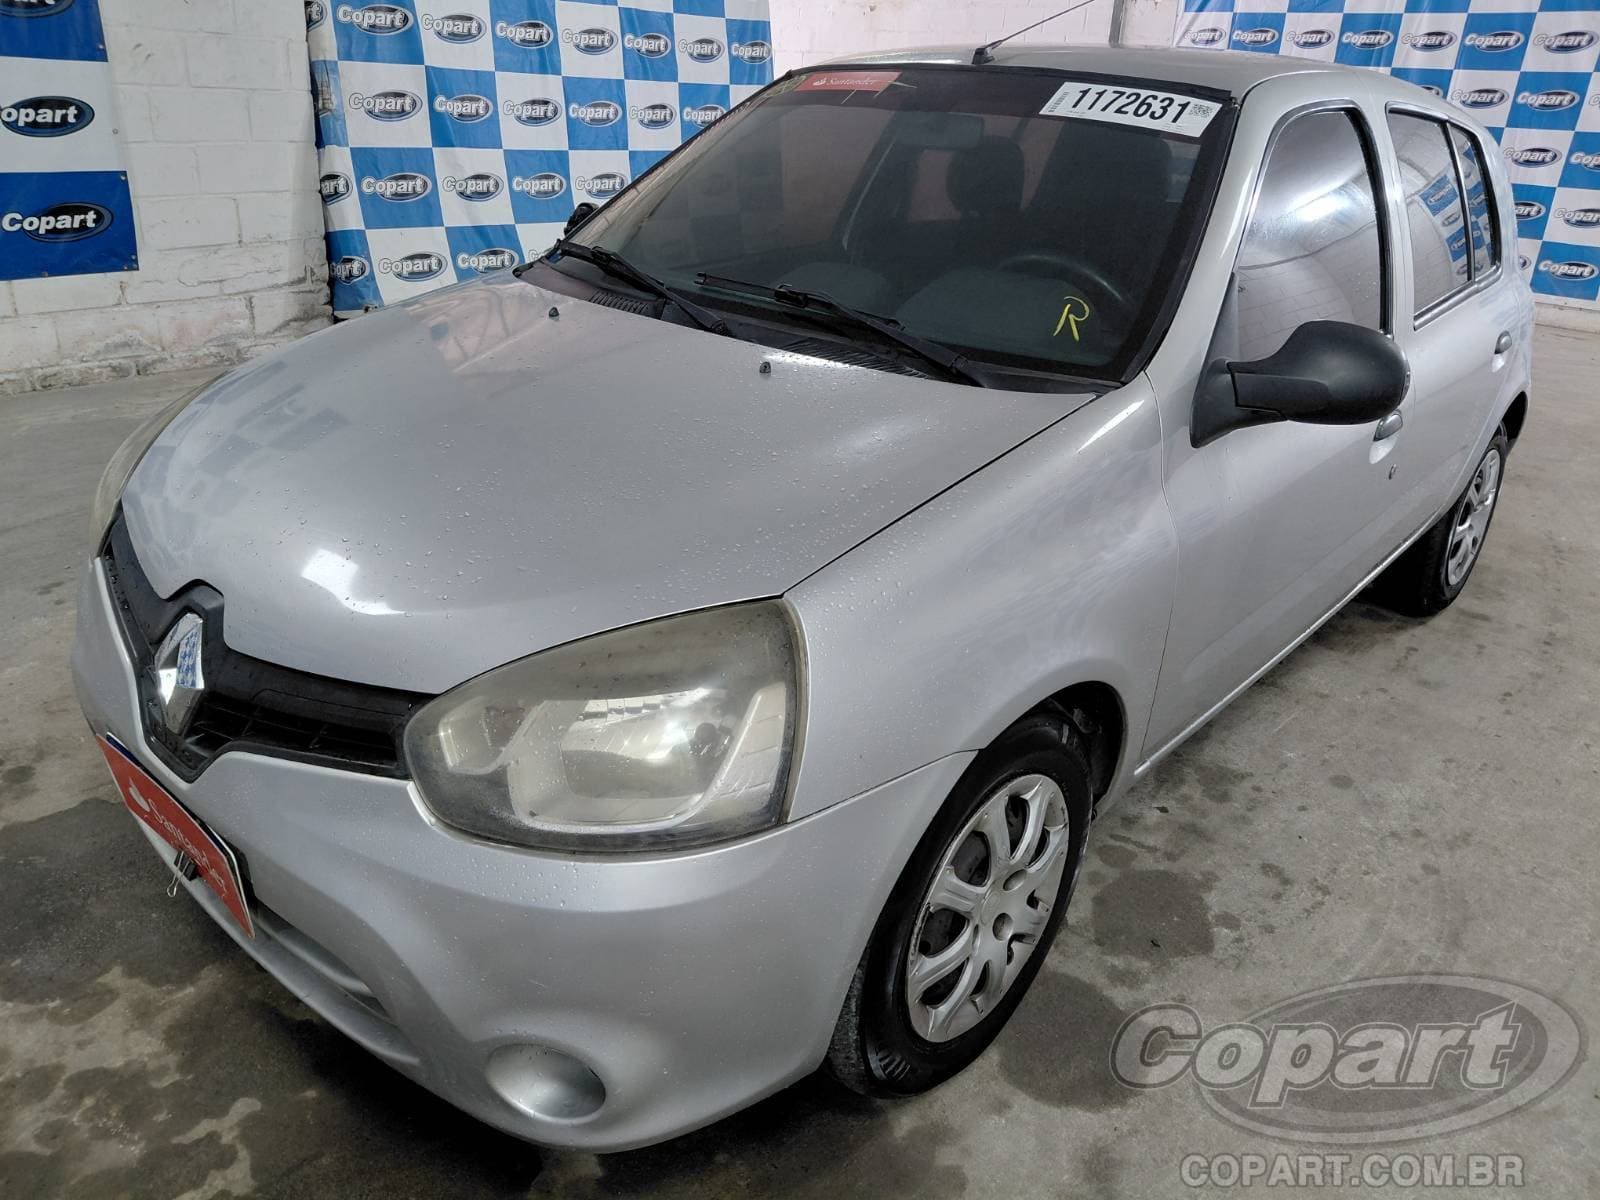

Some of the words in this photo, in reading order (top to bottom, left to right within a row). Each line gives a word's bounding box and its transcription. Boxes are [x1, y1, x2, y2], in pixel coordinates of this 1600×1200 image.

[337, 5, 405, 27] Copart
[421, 14, 478, 35] Copart
[496, 22, 548, 41] Copart
[562, 28, 610, 46] Copart
[1184, 30, 1220, 42] Copart
[1232, 29, 1273, 42] Copart
[1286, 31, 1328, 44] Copart
[1341, 31, 1387, 46] Copart
[1402, 32, 1449, 46] Copart
[1533, 32, 1589, 48] Copart
[624, 34, 666, 51] Copart
[678, 39, 719, 55] Copart
[1464, 33, 1517, 48] Copart
[731, 43, 767, 58] Copart
[349, 92, 413, 113] Copart
[435, 95, 486, 115] Copart
[1451, 89, 1500, 104] Copart
[1517, 92, 1572, 107] Copart
[503, 100, 554, 120] Copart
[569, 102, 616, 120] Copart
[1072, 88, 1191, 123] 1172631
[0, 105, 78, 127] opart
[629, 106, 671, 123] Copart
[1503, 147, 1555, 162] Copart
[361, 175, 422, 196] Copart
[443, 176, 495, 196] Copart
[512, 176, 561, 194] Copart
[575, 176, 620, 192] Copart
[1515, 206, 1540, 217] art
[1555, 208, 1600, 224] Copar
[1, 209, 97, 234] Copart
[379, 257, 438, 277] Copart
[457, 252, 510, 270] Copart
[1539, 260, 1591, 277] Copart
[1053, 296, 1090, 342] R
